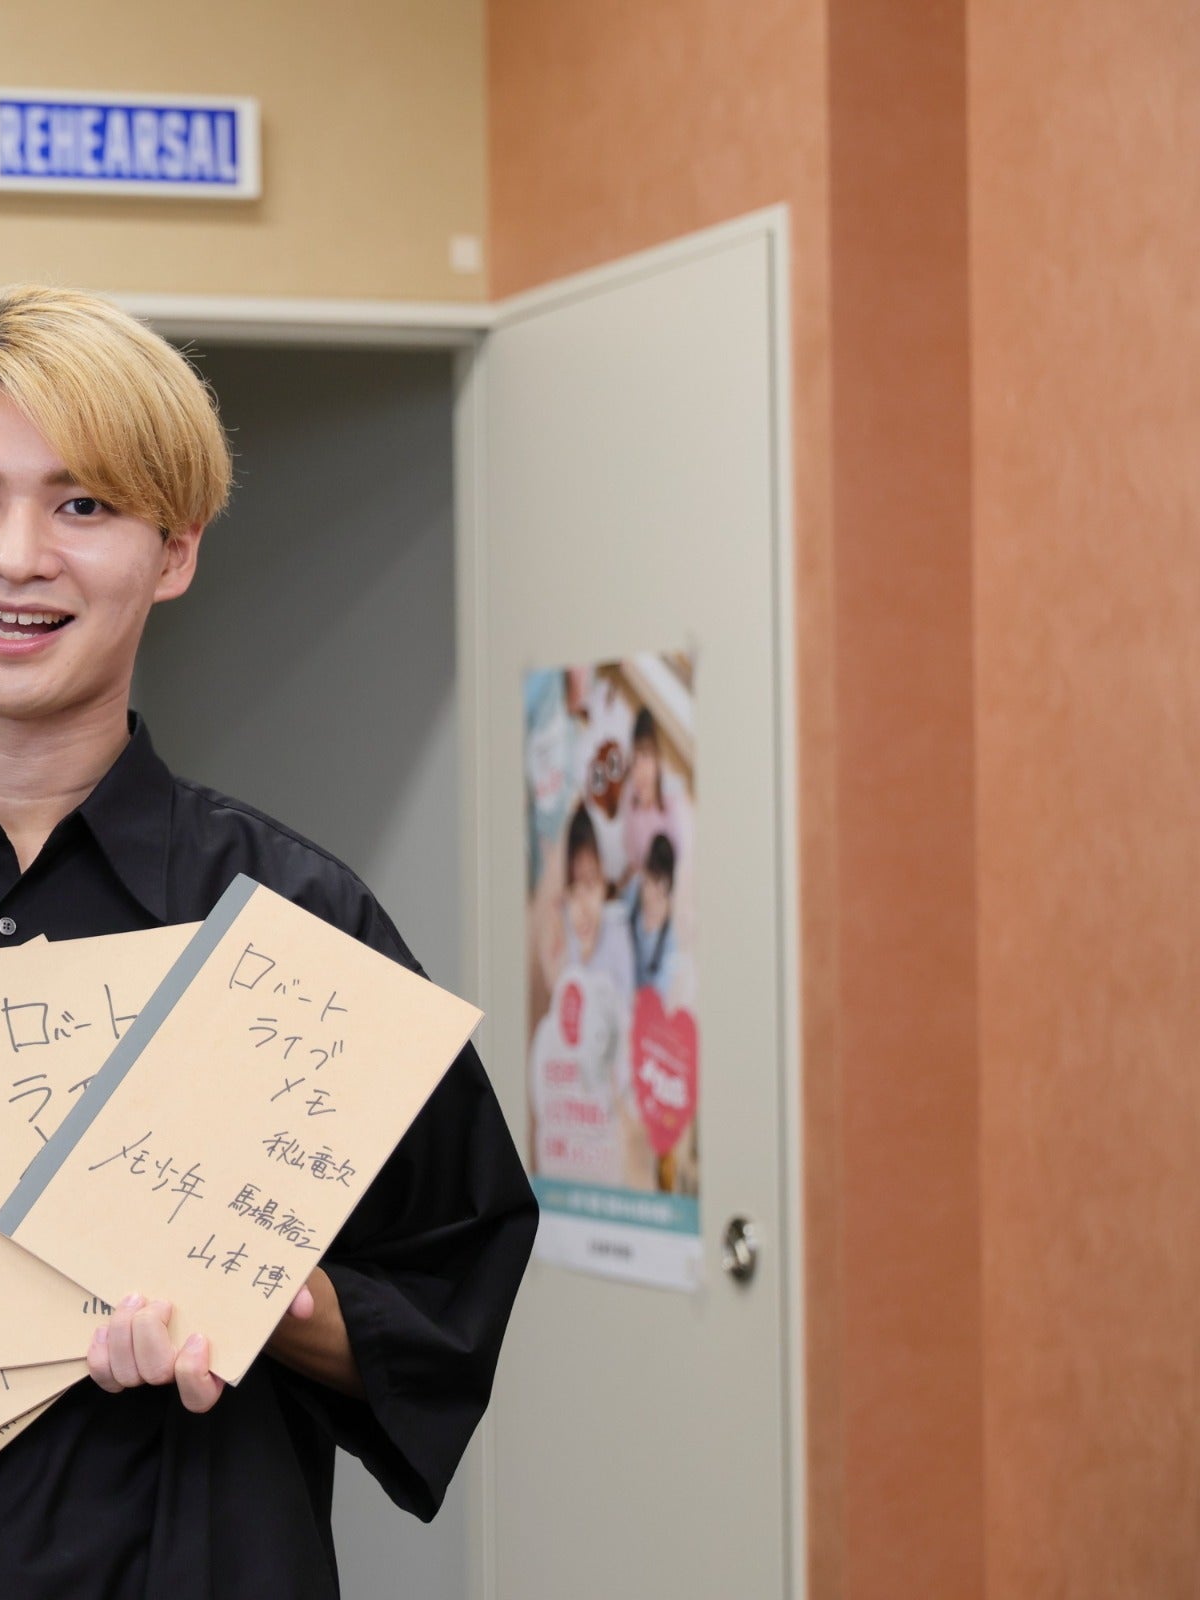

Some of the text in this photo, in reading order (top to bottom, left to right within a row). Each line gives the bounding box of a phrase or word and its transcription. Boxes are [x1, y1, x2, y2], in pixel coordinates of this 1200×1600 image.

[0, 105, 236, 180] REHEARSAL
[228, 942, 349, 1022] ロバート
[1, 984, 139, 1053] ロバート
[249, 1017, 344, 1071] ライブ
[270, 1077, 337, 1117] メモ
[88, 1130, 206, 1225] メモ少年
